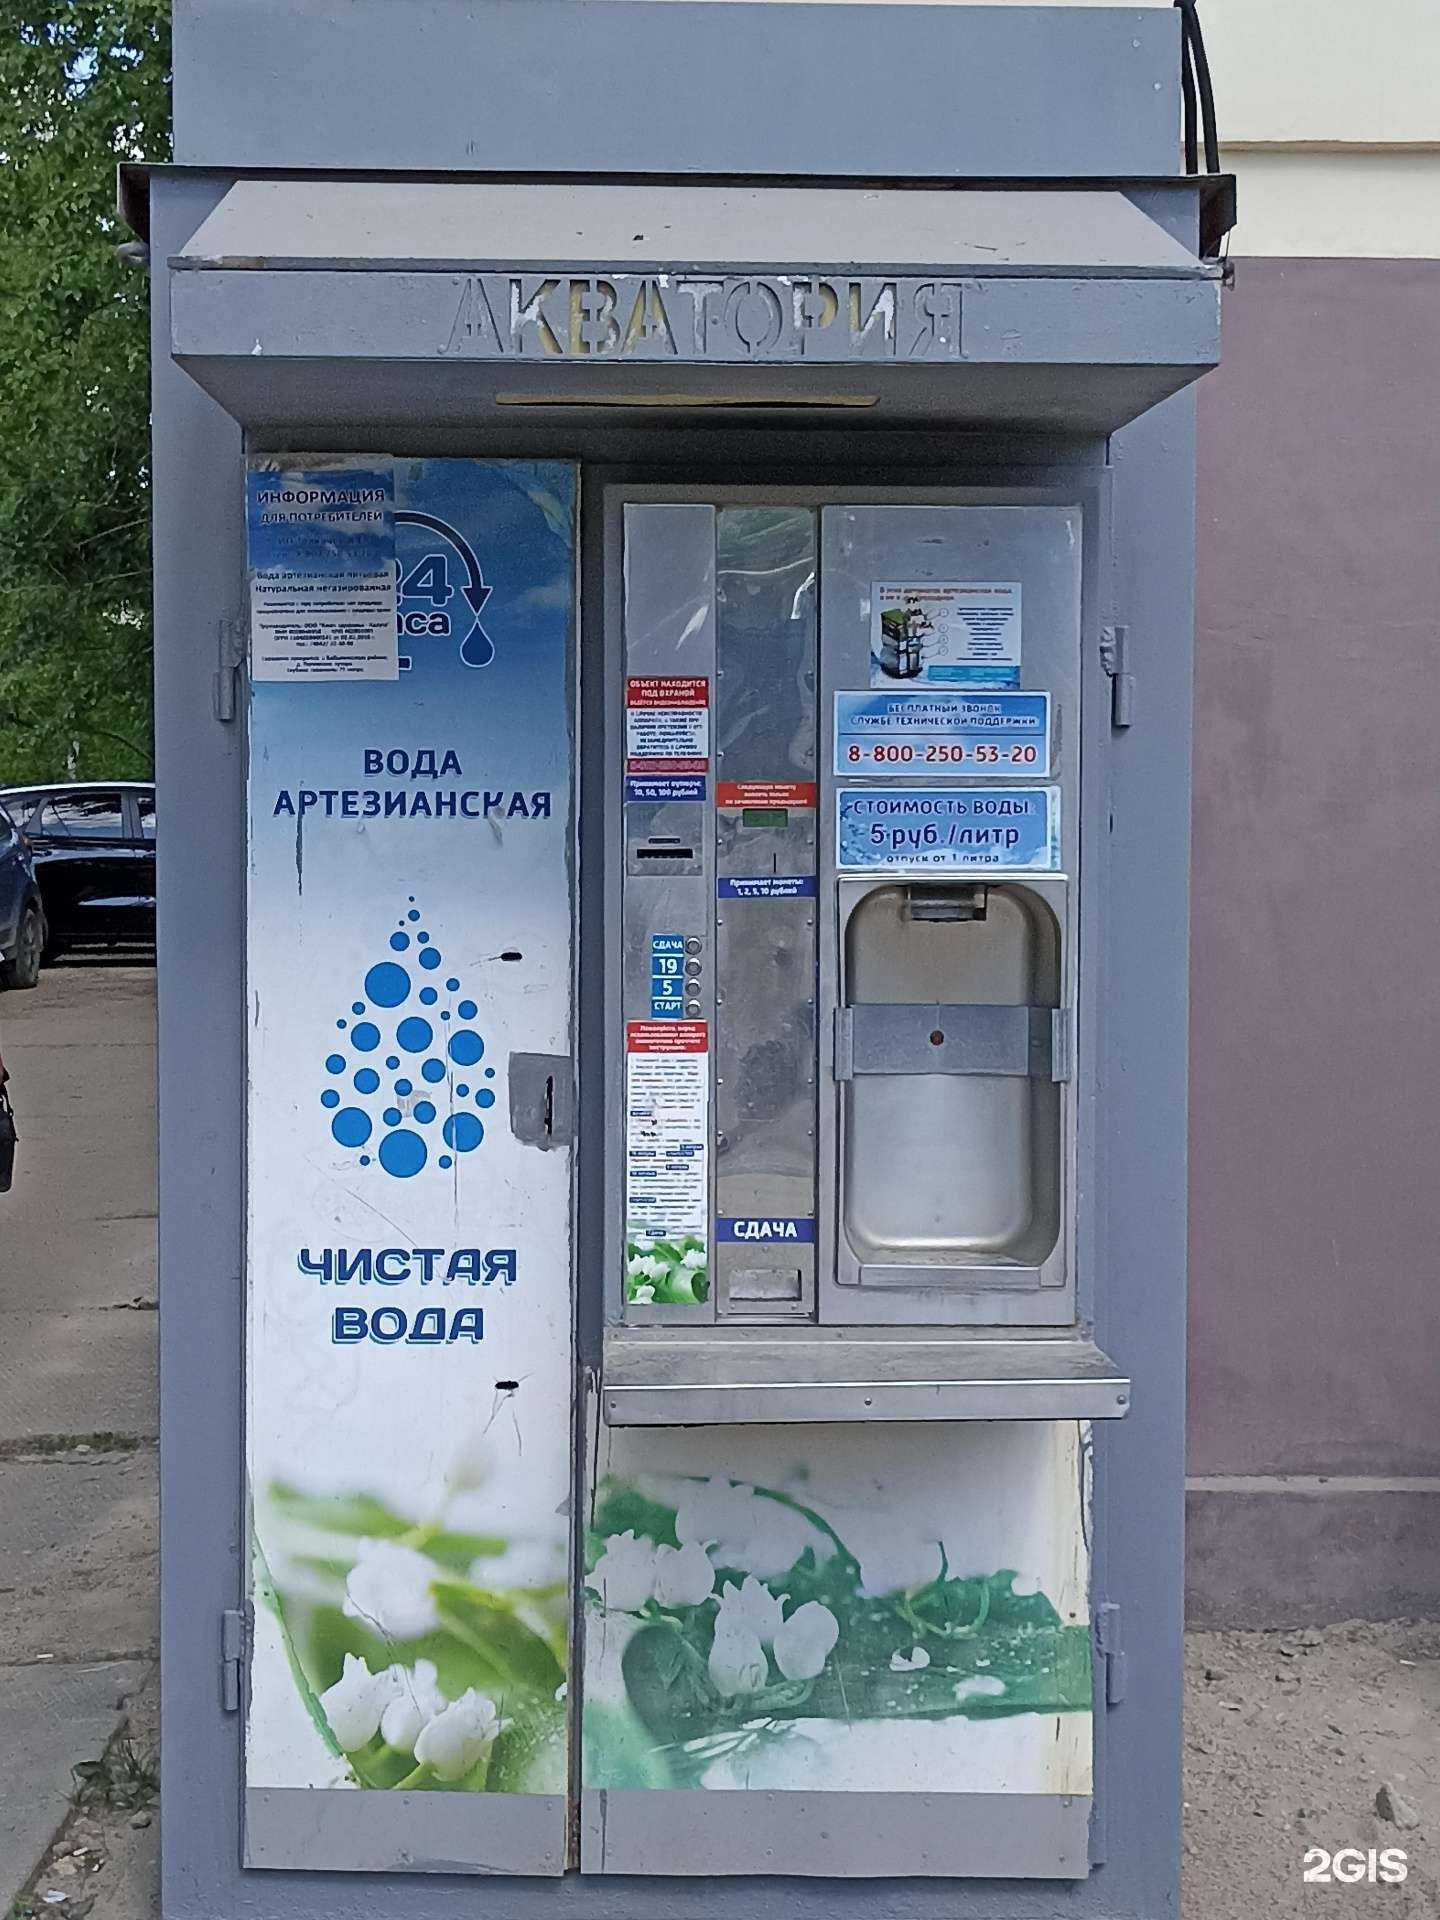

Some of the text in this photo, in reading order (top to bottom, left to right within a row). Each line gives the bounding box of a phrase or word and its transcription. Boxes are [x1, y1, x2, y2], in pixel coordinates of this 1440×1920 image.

[440, 278, 967, 357] АКВАТОРИЯ
[257, 490, 385, 505] ИНФОРМАЦИЯ
[397, 554, 454, 607] 4
[256, 584, 315, 594] Натуральная
[659, 689, 695, 697] ОХРАНОЙ
[971, 717, 1035, 726] ПОДДЕРЖКИ
[848, 745, 1037, 762] 8-800-250-53-20
[364, 750, 462, 779] ВОДА
[273, 790, 551, 817] АРТЕЗИАНСКАЯ
[853, 800, 1028, 815] СТОИМОСТЬ ВОДЫ
[653, 941, 683, 949] СДАЧА
[659, 958, 678, 974] 19
[662, 980, 673, 996] 5
[654, 1002, 680, 1010] СТАРТ
[733, 1221, 798, 1239] СДАЧА
[298, 1249, 517, 1285] ЧИСТАЯ
[332, 1307, 484, 1344] ВОДА
